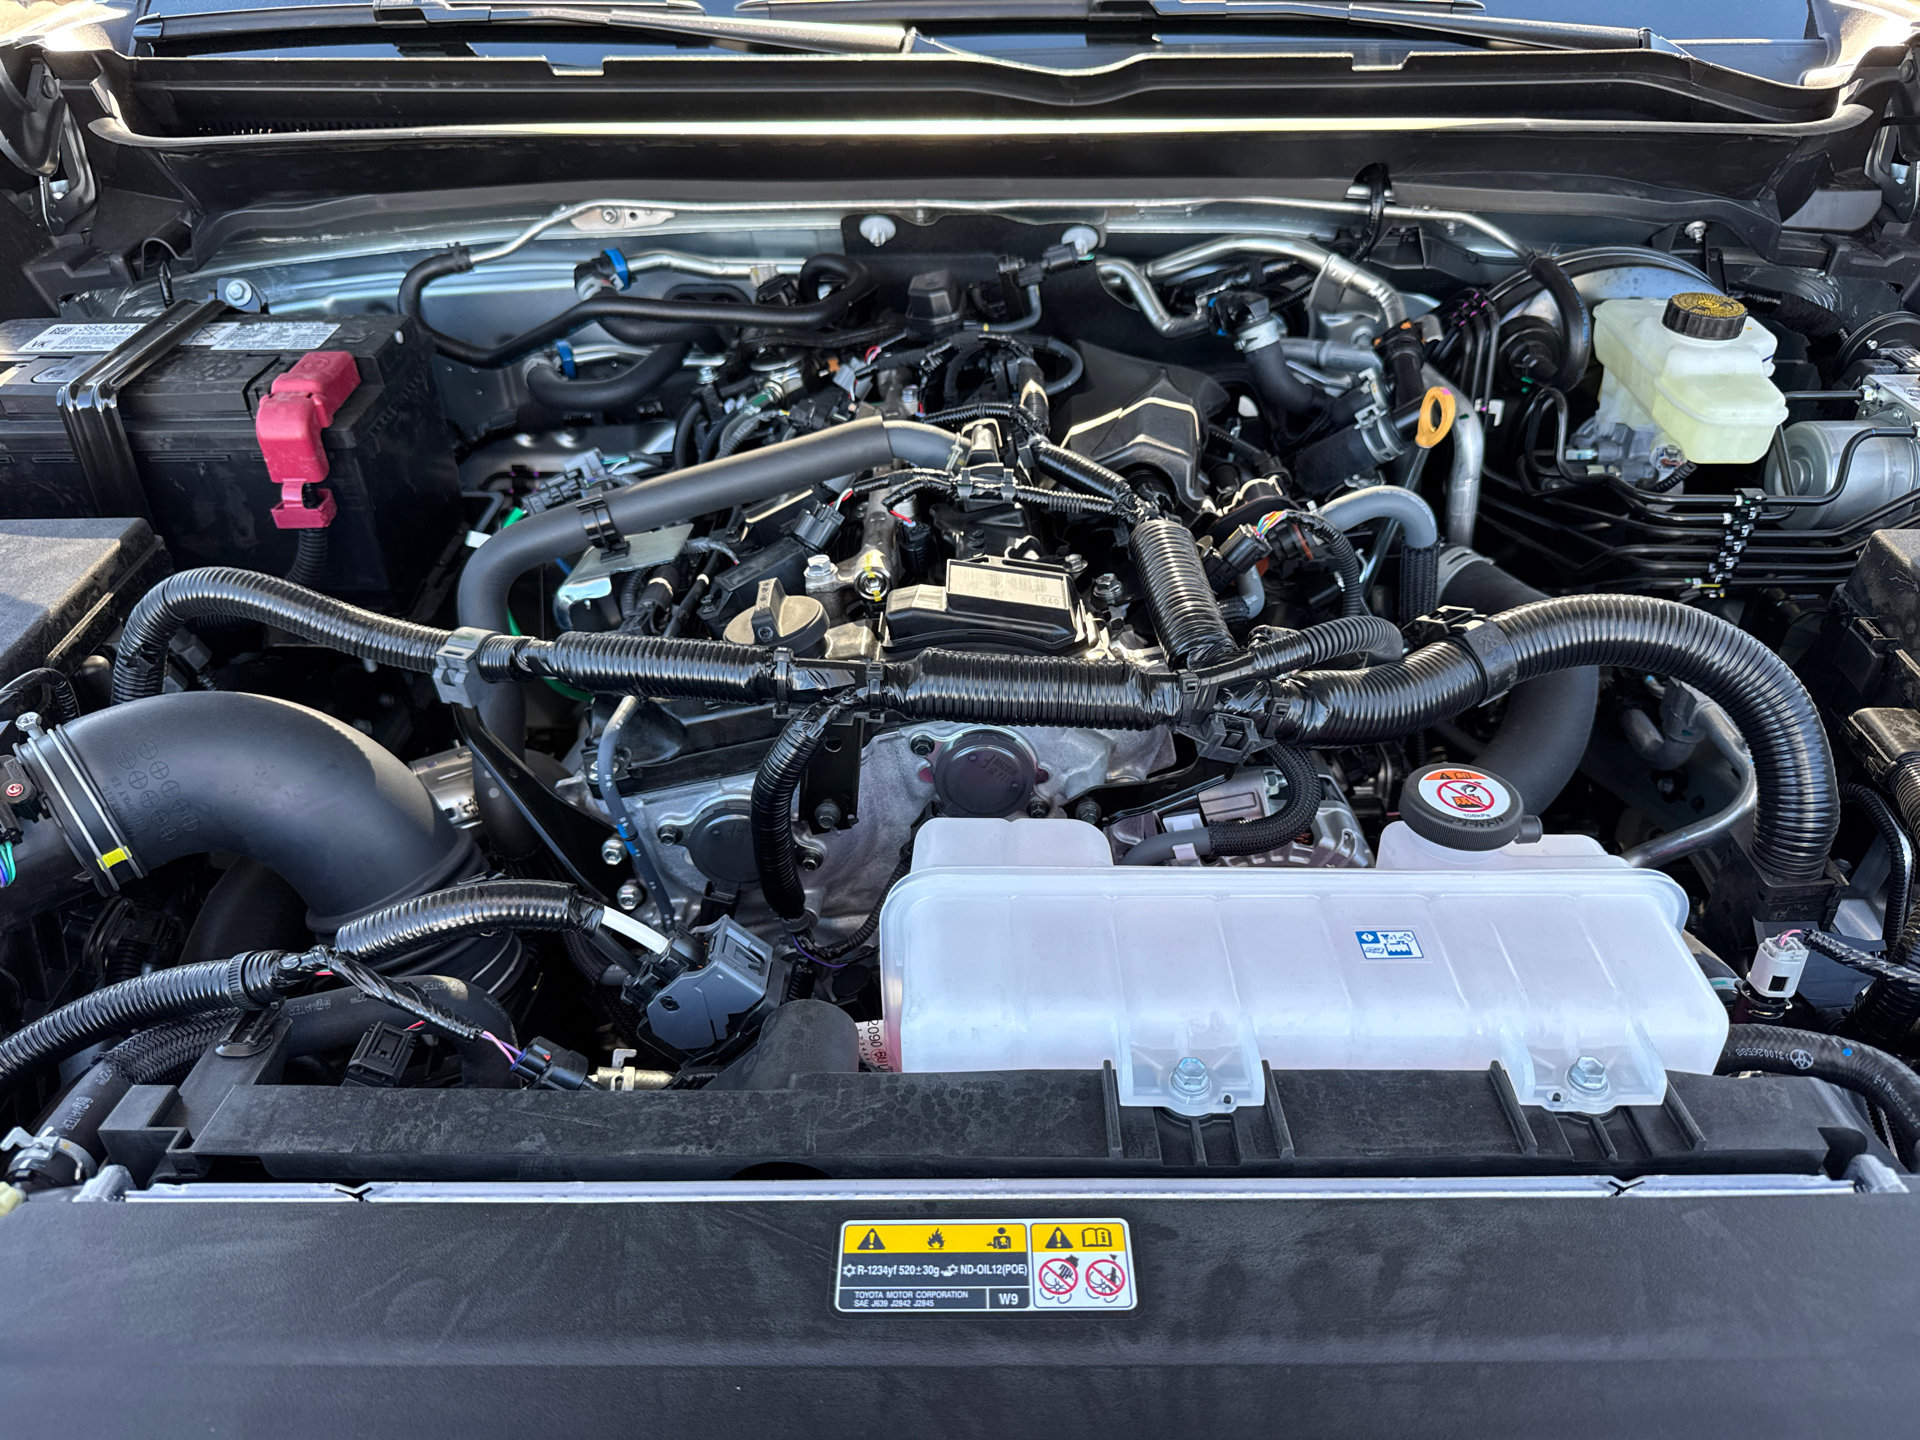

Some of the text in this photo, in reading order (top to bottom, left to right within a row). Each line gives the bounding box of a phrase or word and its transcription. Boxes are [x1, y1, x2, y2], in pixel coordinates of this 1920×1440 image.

[858, 1264, 1028, 1278] R-1234yf 520±30g ND-OIL12(POE)
[854, 1290, 969, 1299] TOYOTA MOTOR CORPORATION
[998, 1293, 1019, 1306] W9
[853, 1300, 869, 1308] SAE
[871, 1299, 888, 1308] J639
